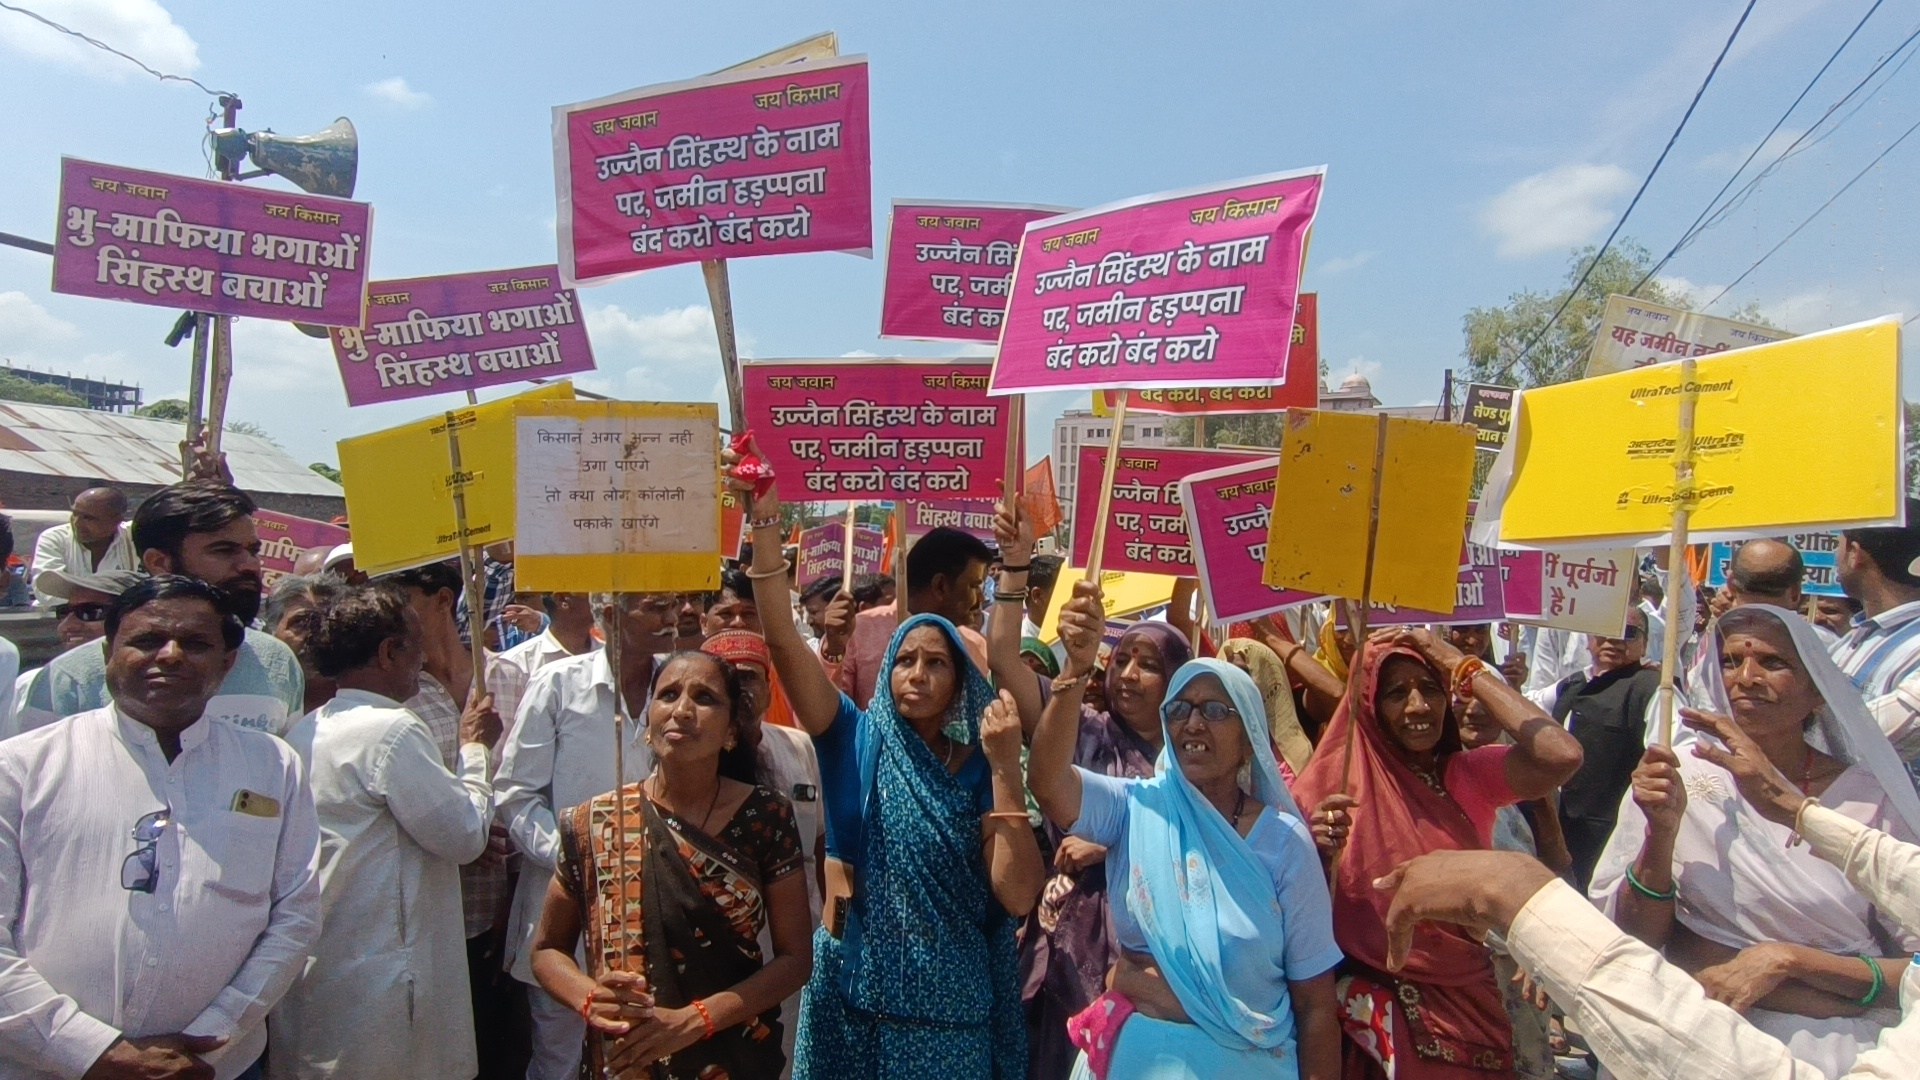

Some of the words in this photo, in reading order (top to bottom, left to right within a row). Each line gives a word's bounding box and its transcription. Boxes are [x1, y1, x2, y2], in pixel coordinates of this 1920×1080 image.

[592, 118, 616, 136] जय
[619, 109, 658, 131] जवान
[754, 92, 782, 110] जय
[786, 82, 841, 105] किसान
[596, 141, 663, 180] उज्जैन
[667, 134, 747, 170] सिंहस्थ
[752, 126, 781, 158] के
[784, 122, 840, 152] नाम
[91, 178, 118, 194] जय
[126, 183, 168, 200] जवान
[265, 203, 290, 218] जय
[294, 204, 341, 225] किसान
[616, 190, 651, 218] पर,
[655, 174, 728, 210] जमीन
[733, 167, 826, 208] हड़प्पना
[631, 223, 663, 254] बंद
[667, 216, 712, 250] करो
[717, 212, 753, 244] बंद
[758, 205, 810, 239] करो
[917, 216, 940, 228] जय
[944, 217, 981, 229] जवान
[1042, 237, 1062, 253] जय
[1064, 228, 1100, 248] जवान
[1190, 208, 1216, 225] जय
[1222, 196, 1282, 220] किसान
[67, 204, 246, 256] भु-माफिया
[252, 233, 361, 271] भगाओं
[916, 238, 982, 264] उज्जैन
[96, 244, 215, 297] सिंहस्थ
[222, 271, 329, 308] बचाओं
[1034, 260, 1096, 296] उज्जैन
[1096, 250, 1174, 286] सिंहस्थ
[1176, 240, 1205, 273] के
[1208, 235, 1270, 268] नाम
[374, 292, 410, 305] जवान
[488, 282, 509, 294] जय
[510, 277, 550, 292] किसान
[931, 274, 964, 298] पर,
[488, 292, 576, 332] भगाओं
[942, 301, 974, 326] बंद
[1042, 306, 1071, 334] पर,
[1076, 291, 1146, 327] जमीन
[1150, 286, 1246, 328] हड़प्पना
[1046, 337, 1074, 370] बंद
[1077, 332, 1122, 368] करो
[1125, 328, 1160, 364] बंद
[1165, 326, 1220, 362] करो
[1611, 326, 1638, 347] यह
[1640, 332, 1690, 357] जमीन
[376, 352, 472, 388] सिंहस्थ
[475, 331, 562, 374] बचाओं
[770, 376, 792, 390] जय
[796, 376, 835, 390] जवान
[924, 375, 949, 388] जय
[951, 372, 990, 389] किसा
[1684, 380, 1734, 392] Cement
[771, 399, 840, 427] उज्जैन
[843, 400, 917, 427] सिंहस्थ
[921, 400, 945, 426] के
[950, 406, 997, 426] नाम
[590, 432, 622, 444] अगर
[791, 439, 826, 464] पर,
[830, 432, 898, 460] जमीन
[902, 438, 983, 464] हड़प्पना
[582, 460, 608, 472] उगा
[1125, 458, 1158, 470] जवान
[805, 467, 836, 492] बंद
[840, 466, 886, 492] करो
[890, 466, 920, 492] बंद
[925, 466, 970, 492] करो
[1217, 486, 1238, 500] जय
[545, 486, 562, 502] तो
[569, 489, 595, 502] क्या
[604, 487, 630, 502] लोग
[638, 486, 686, 502] कॉलोनी
[574, 515, 614, 530] पकाके
[916, 502, 962, 528] सिंहस्थ
[1115, 513, 1144, 535] पर,
[1125, 538, 1154, 562] बंद
[1562, 558, 1619, 590] पूर्वजो
